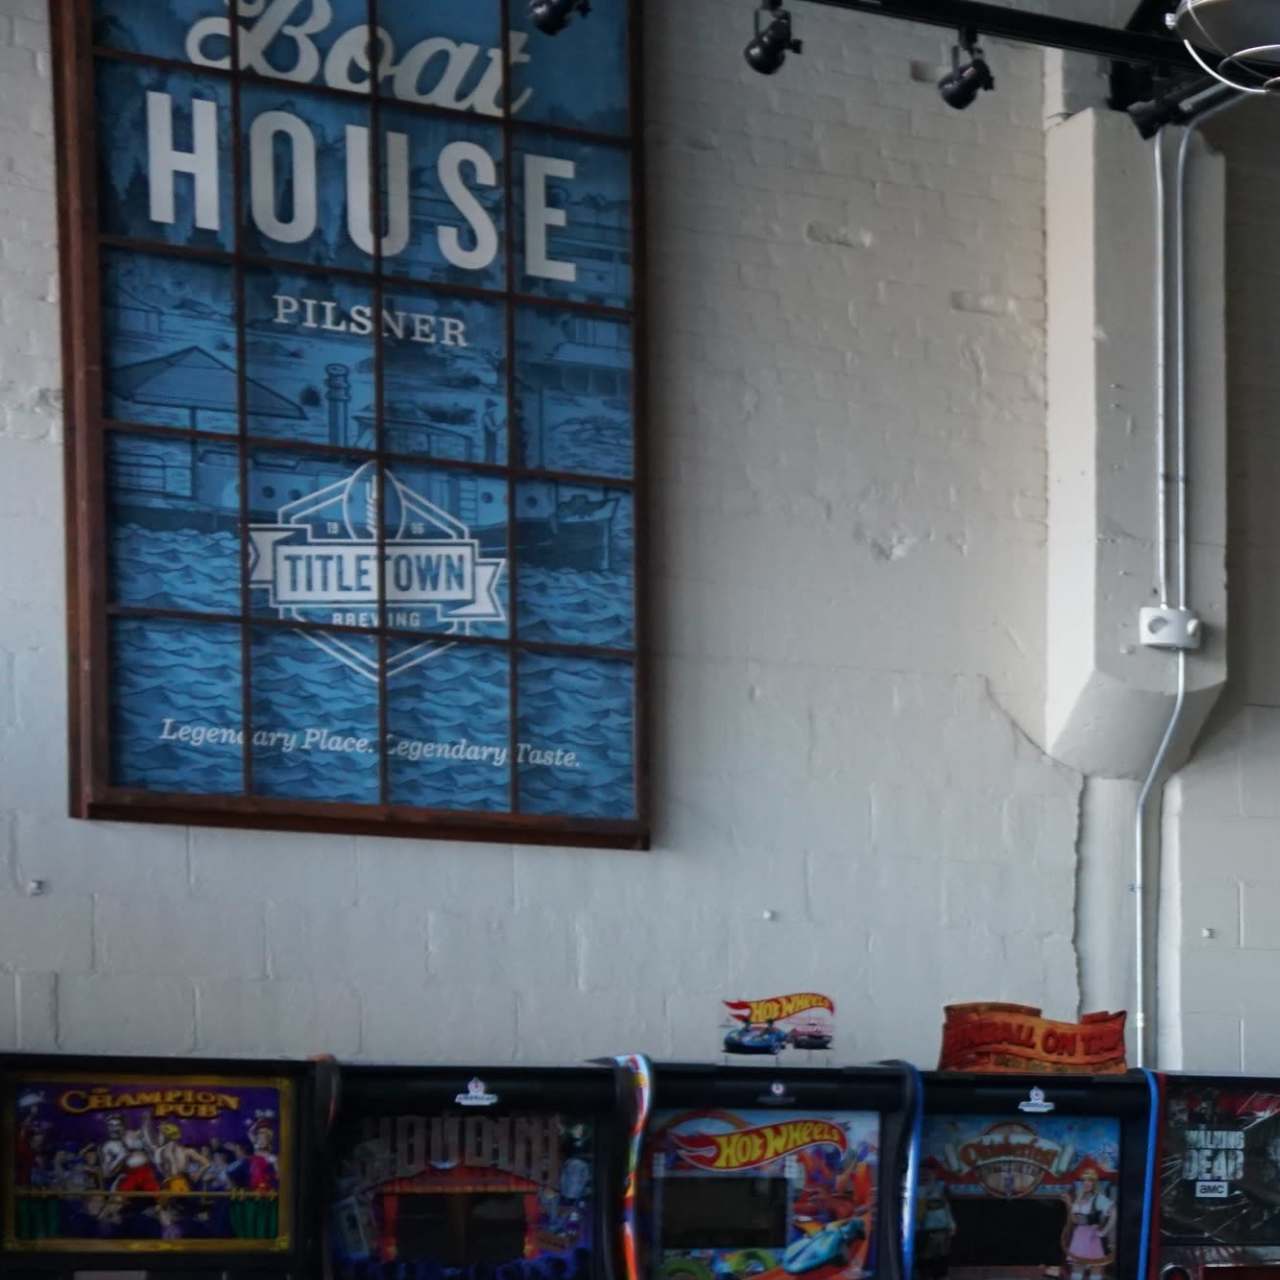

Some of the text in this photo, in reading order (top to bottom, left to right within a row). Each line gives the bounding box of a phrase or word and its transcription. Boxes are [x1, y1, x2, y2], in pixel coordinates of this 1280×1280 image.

[185, 0, 535, 117] Boat
[146, 90, 577, 283] HOUSE
[272, 294, 468, 348] PILSNER
[301, 728, 375, 754] Place.
[750, 1001, 781, 1022] HOT
[59, 1089, 241, 1115] CHAMPION
[154, 1102, 220, 1118] PUB
[718, 1129, 766, 1168] HOT
[1183, 1150, 1246, 1181] DEAD
